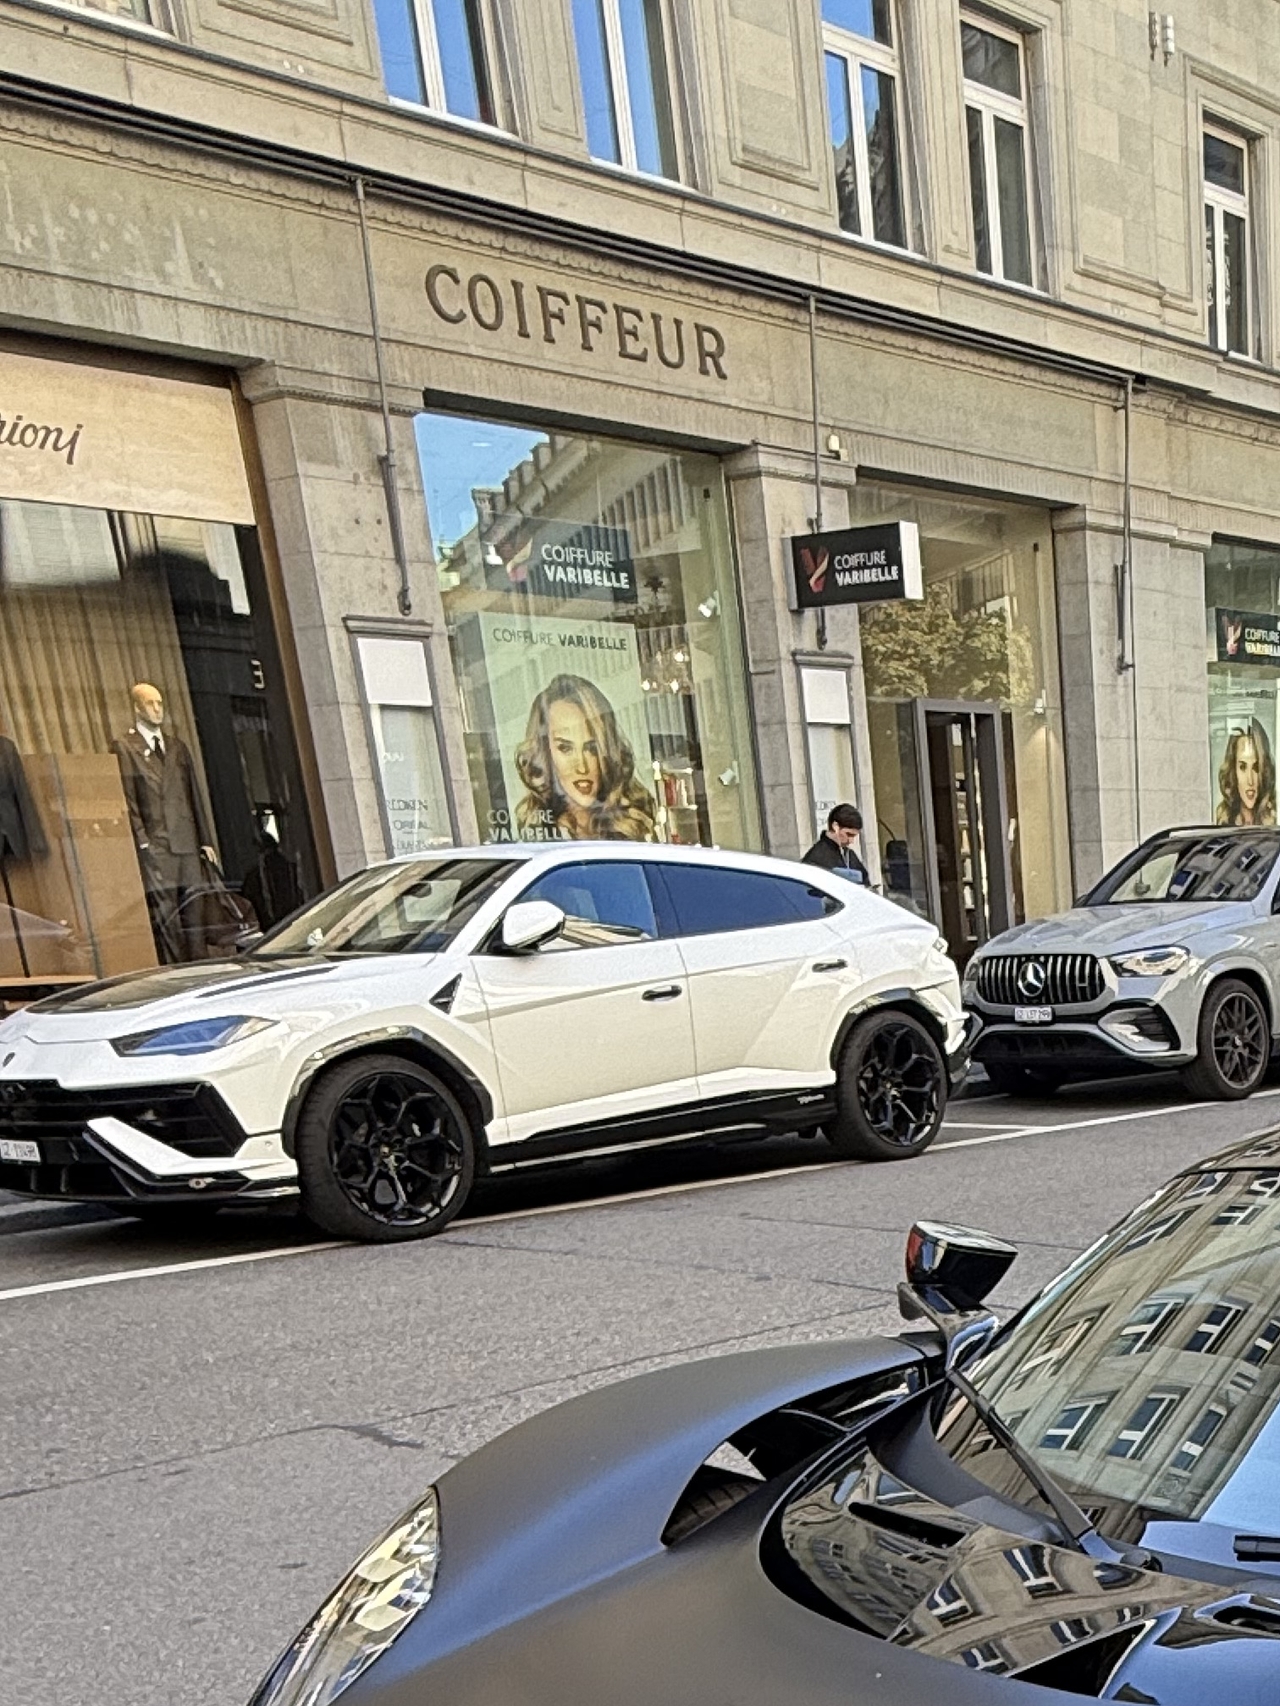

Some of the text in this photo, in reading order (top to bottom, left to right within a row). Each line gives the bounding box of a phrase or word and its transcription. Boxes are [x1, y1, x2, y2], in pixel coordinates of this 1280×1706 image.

[425, 264, 728, 380] COIFFEUR
[541, 544, 613, 568] COIFFURE
[834, 549, 887, 570] COIFFURE
[543, 565, 630, 589] VARIBELLE
[835, 565, 899, 587] VARIBELLE
[557, 633, 627, 650] VARIBELLE
